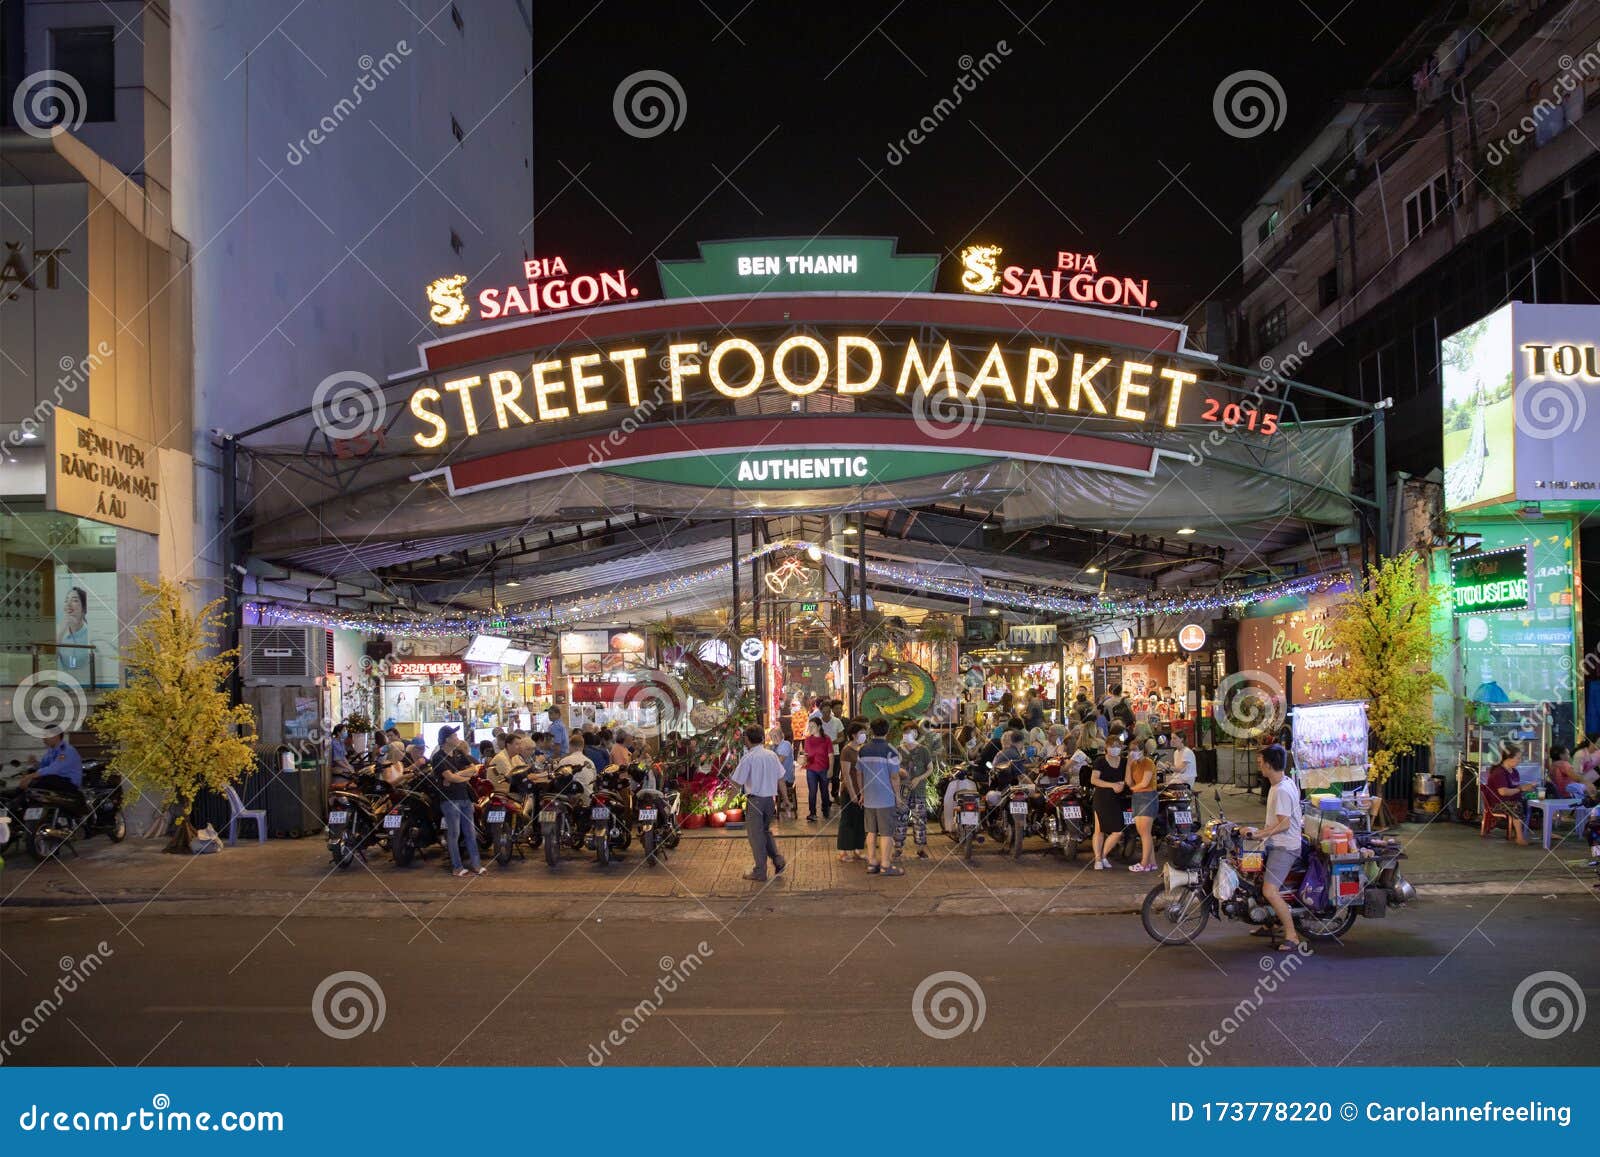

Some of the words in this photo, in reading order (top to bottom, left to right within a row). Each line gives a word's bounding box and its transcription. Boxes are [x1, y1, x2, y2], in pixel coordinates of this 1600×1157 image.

[524, 257, 568, 280] BIA
[737, 256, 781, 275] BEN
[785, 255, 858, 274] THANH
[1058, 251, 1098, 273] BIA
[409, 348, 648, 449] STREET
[668, 335, 883, 403] FOOD
[895, 337, 1197, 428] MARKET
[1201, 398, 1278, 436] 2015
[77, 427, 113, 458] BỆNH
[115, 441, 145, 469] VIỆN
[60, 453, 98, 482] RĂNG
[99, 465, 131, 494] HÀM
[132, 476, 159, 502] MẶT
[737, 456, 868, 482] AUTHENTIC
[96, 490, 107, 515] Á
[108, 494, 127, 518] ÂU
